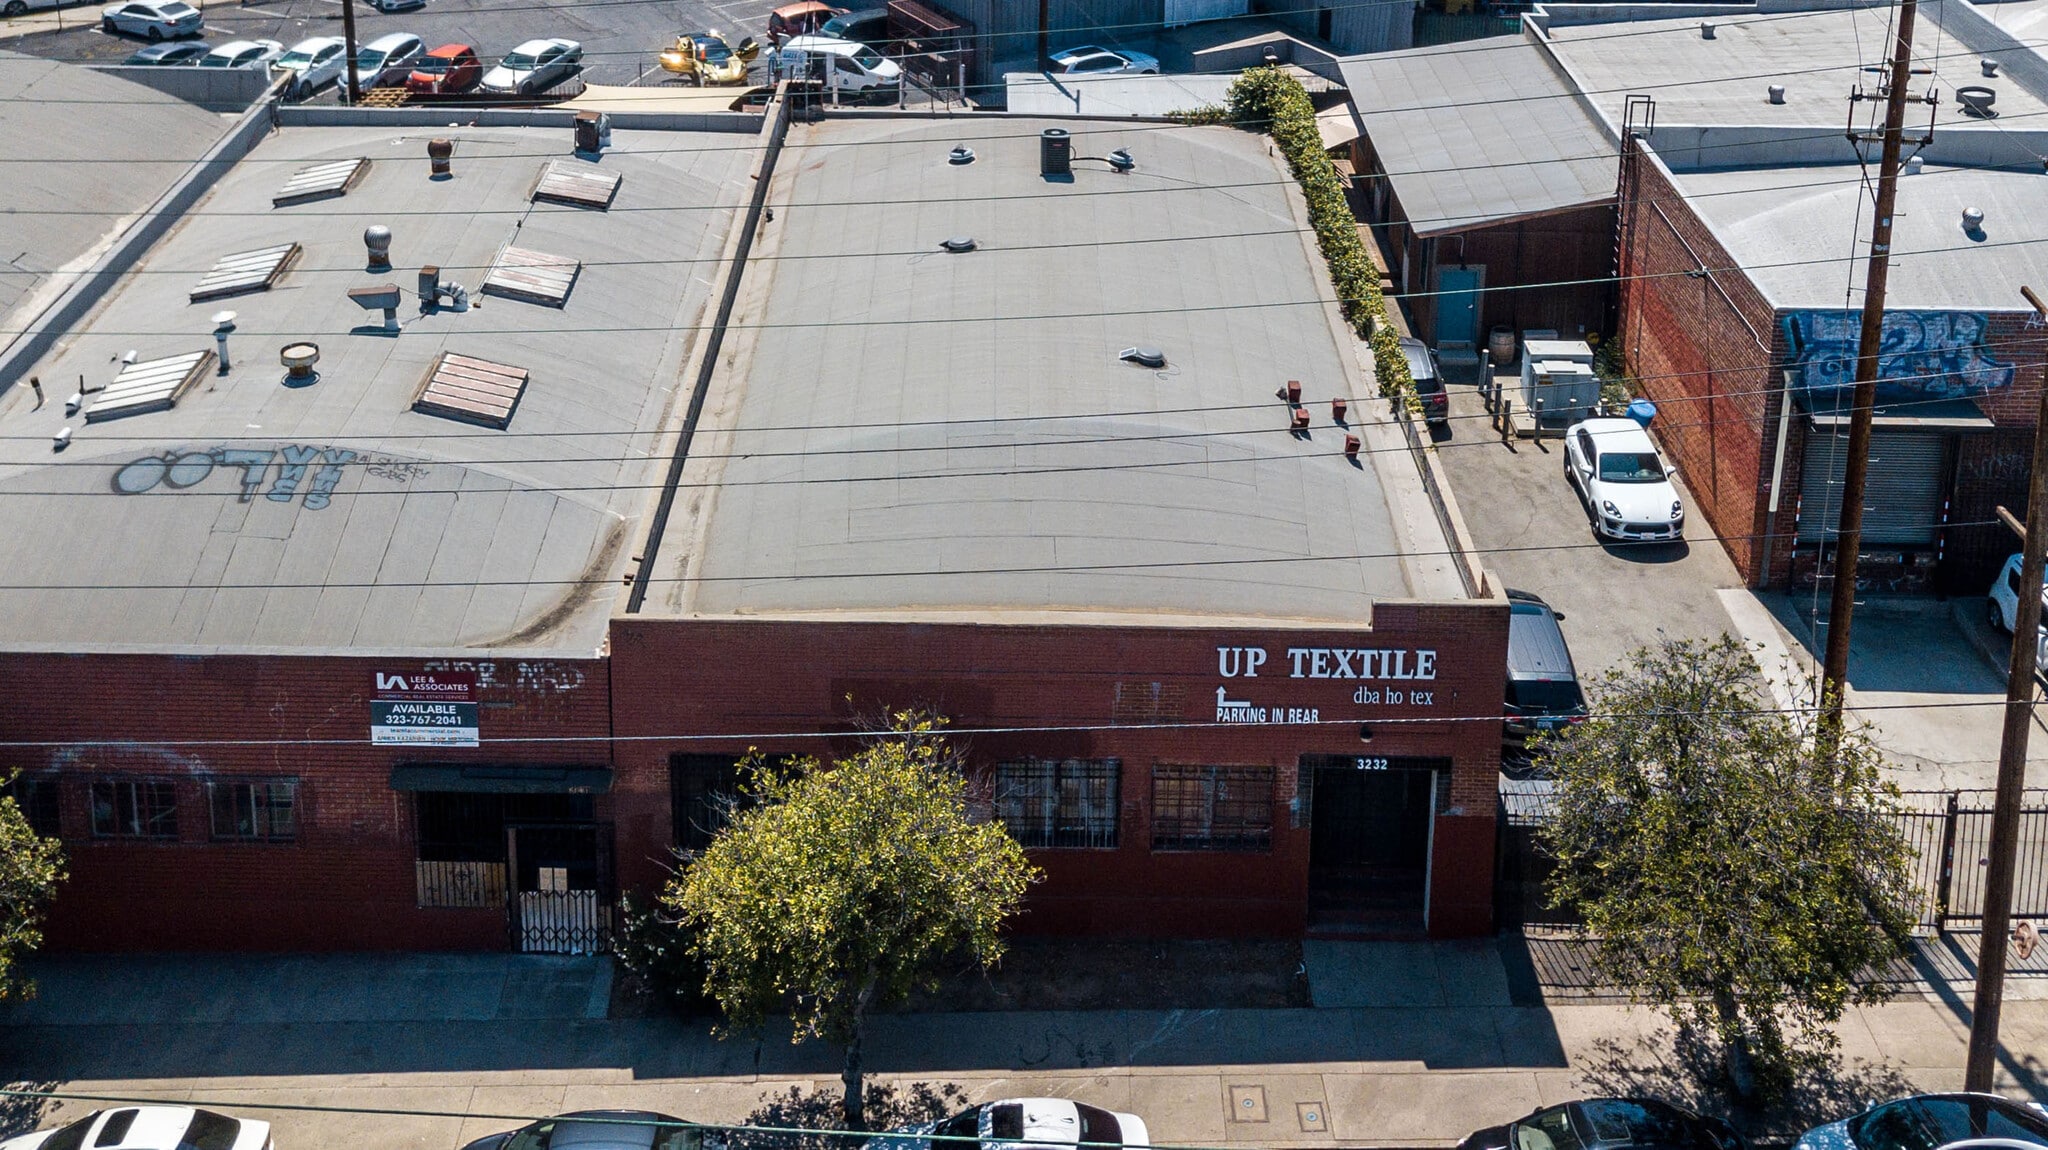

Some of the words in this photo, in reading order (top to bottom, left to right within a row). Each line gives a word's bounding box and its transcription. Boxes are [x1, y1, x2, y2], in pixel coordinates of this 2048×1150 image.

[1217, 648, 1267, 678] UP
[1287, 648, 1437, 680] TEXTILE
[1353, 686, 1380, 704] dba
[1385, 686, 1403, 704] ho
[1410, 690, 1433, 705] tex
[392, 704, 456, 714] AVAILABLE
[1216, 707, 1266, 722] PARKING
[1272, 707, 1284, 723] IN
[1288, 708, 1319, 723] REAR
[386, 715, 462, 725] 323-767-2041
[1357, 759, 1387, 769] 3232
